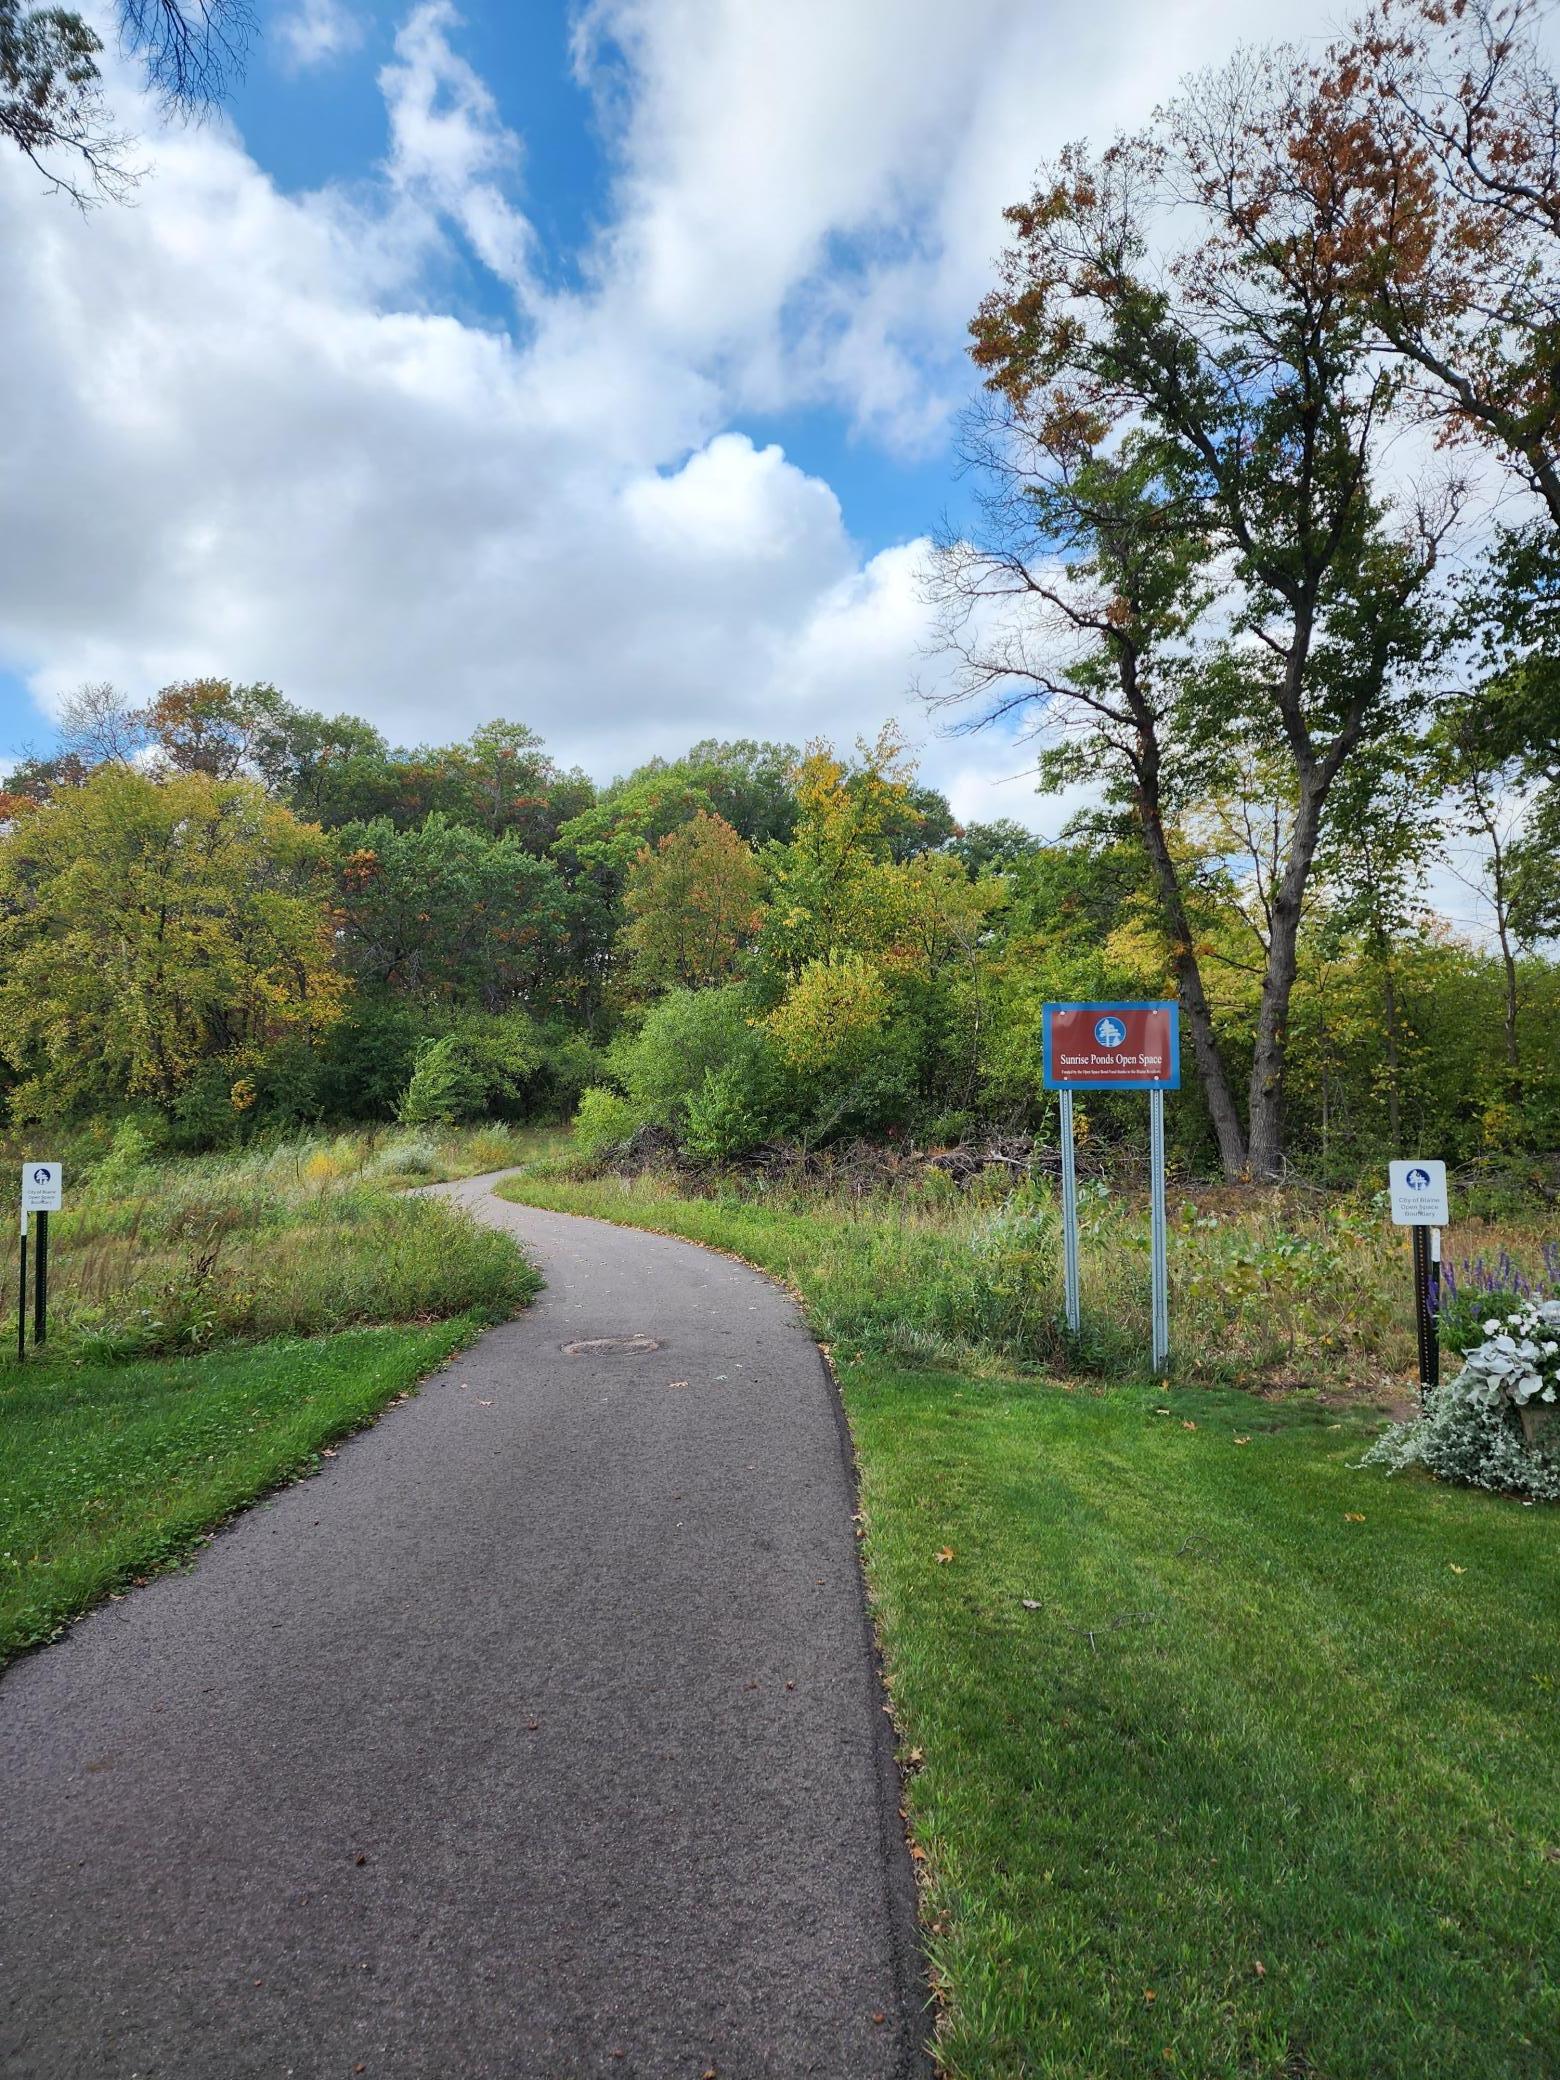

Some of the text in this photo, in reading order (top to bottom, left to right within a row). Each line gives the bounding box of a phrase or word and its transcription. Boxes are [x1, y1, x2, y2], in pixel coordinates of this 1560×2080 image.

[1060, 1053, 1162, 1068] Sunrise Ponds Open Space
